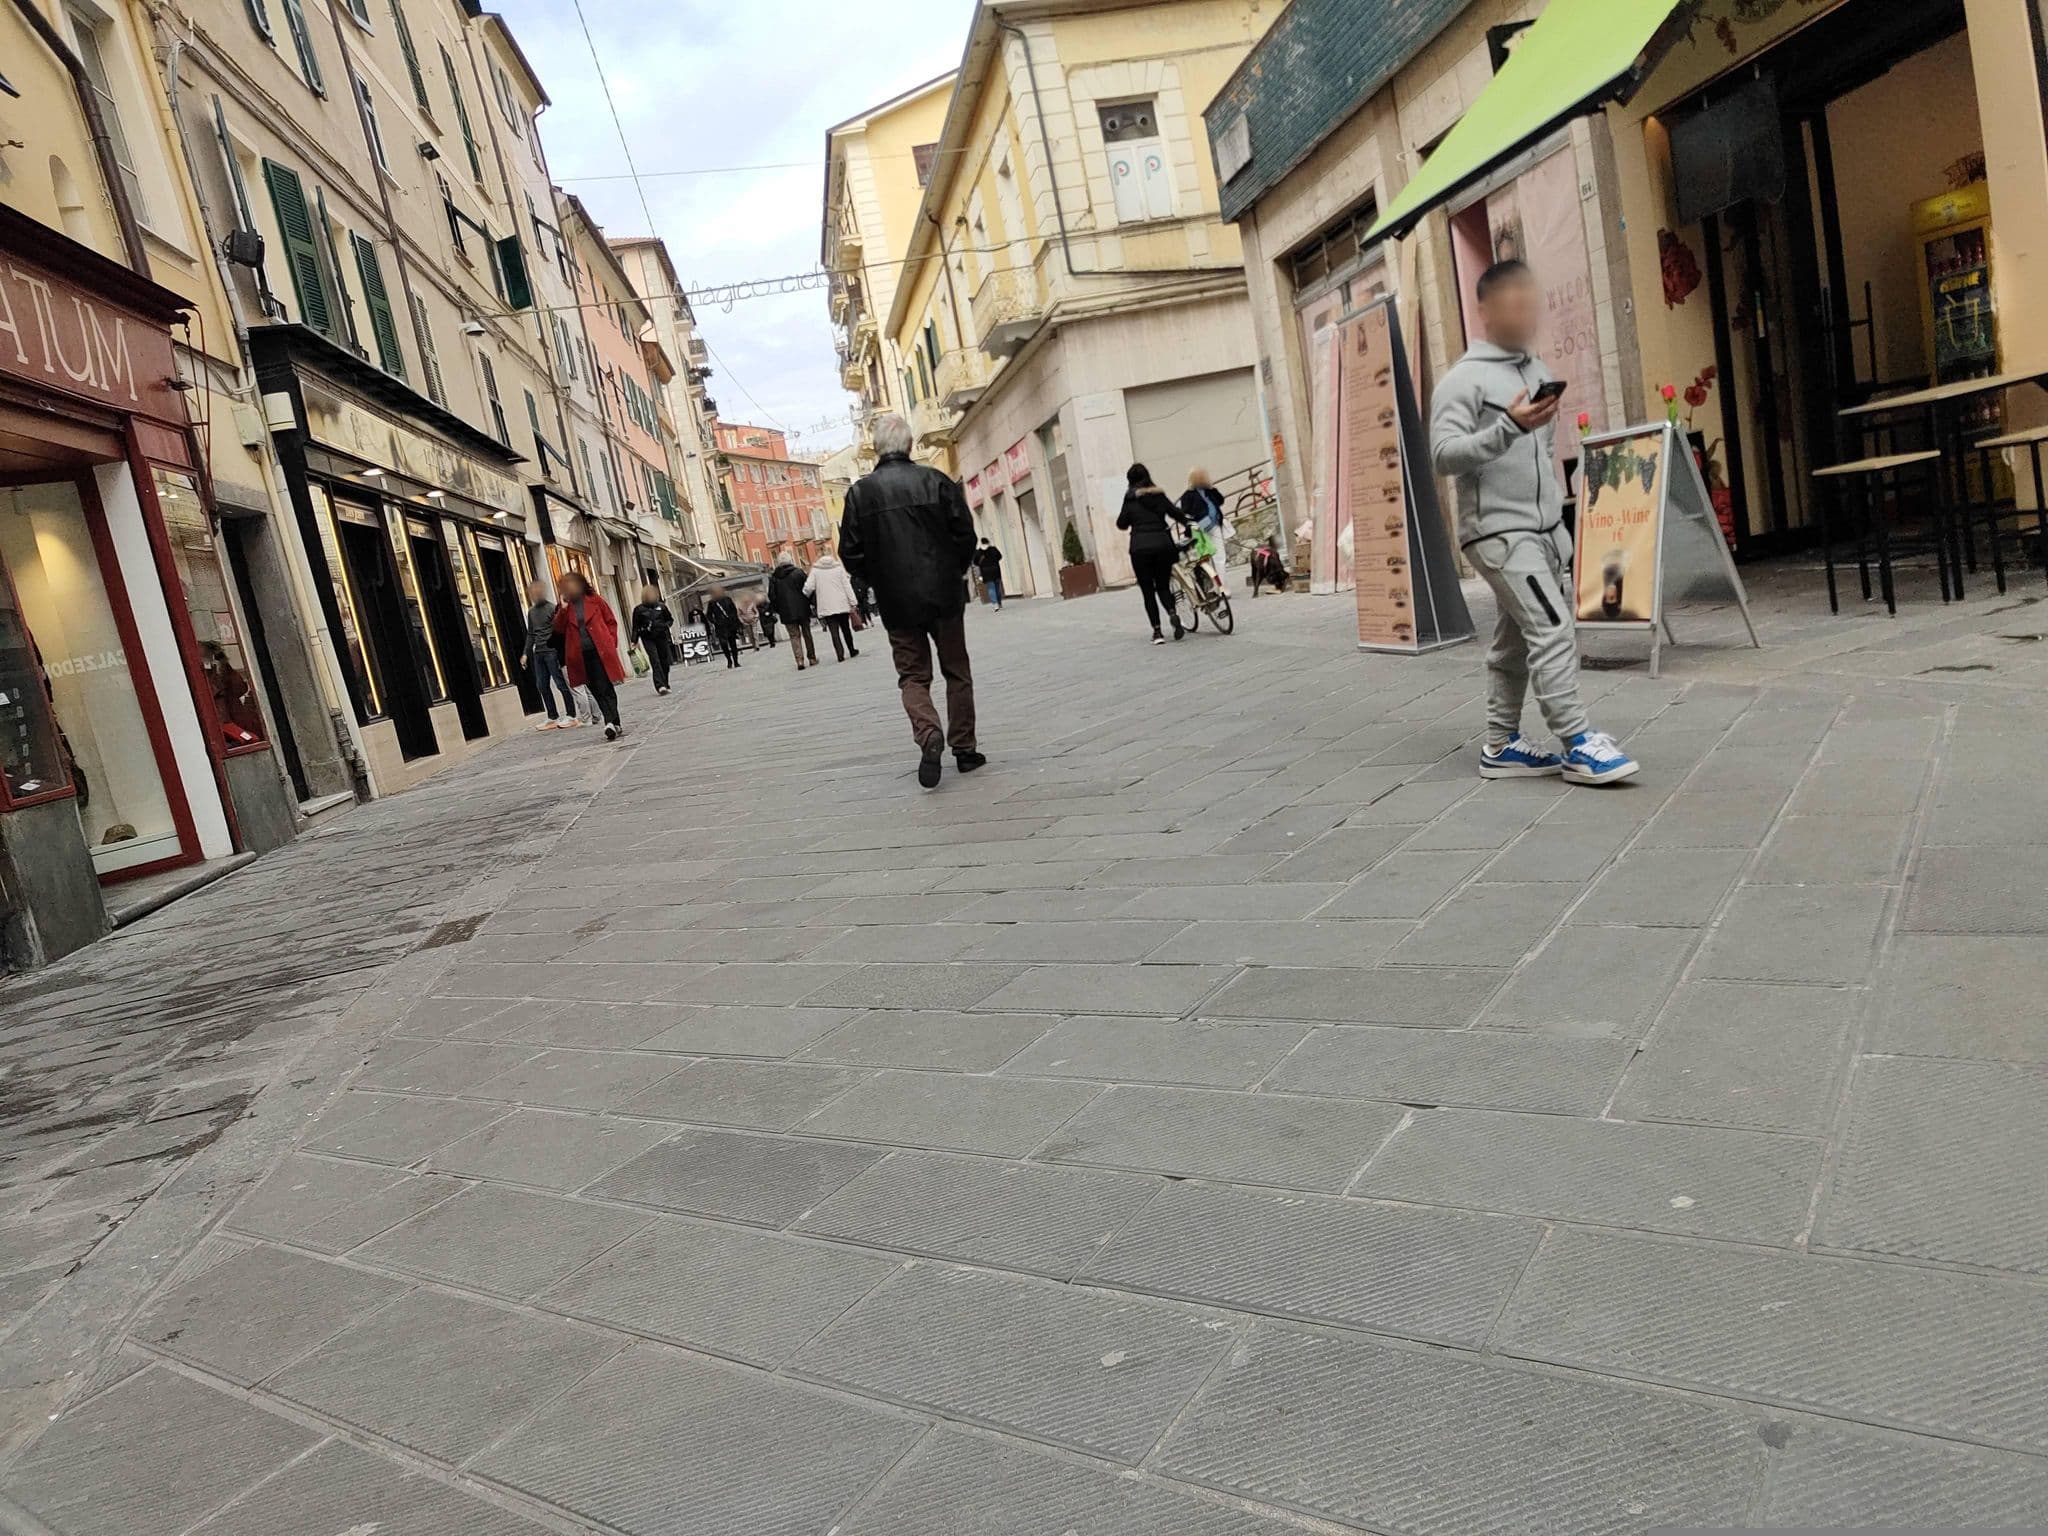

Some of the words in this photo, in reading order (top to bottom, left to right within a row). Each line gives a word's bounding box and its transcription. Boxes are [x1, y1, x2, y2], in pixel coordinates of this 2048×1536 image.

[1587, 511, 1614, 529] Vino
[1622, 506, 1650, 526] Wine
[683, 640, 709, 658] 5€
